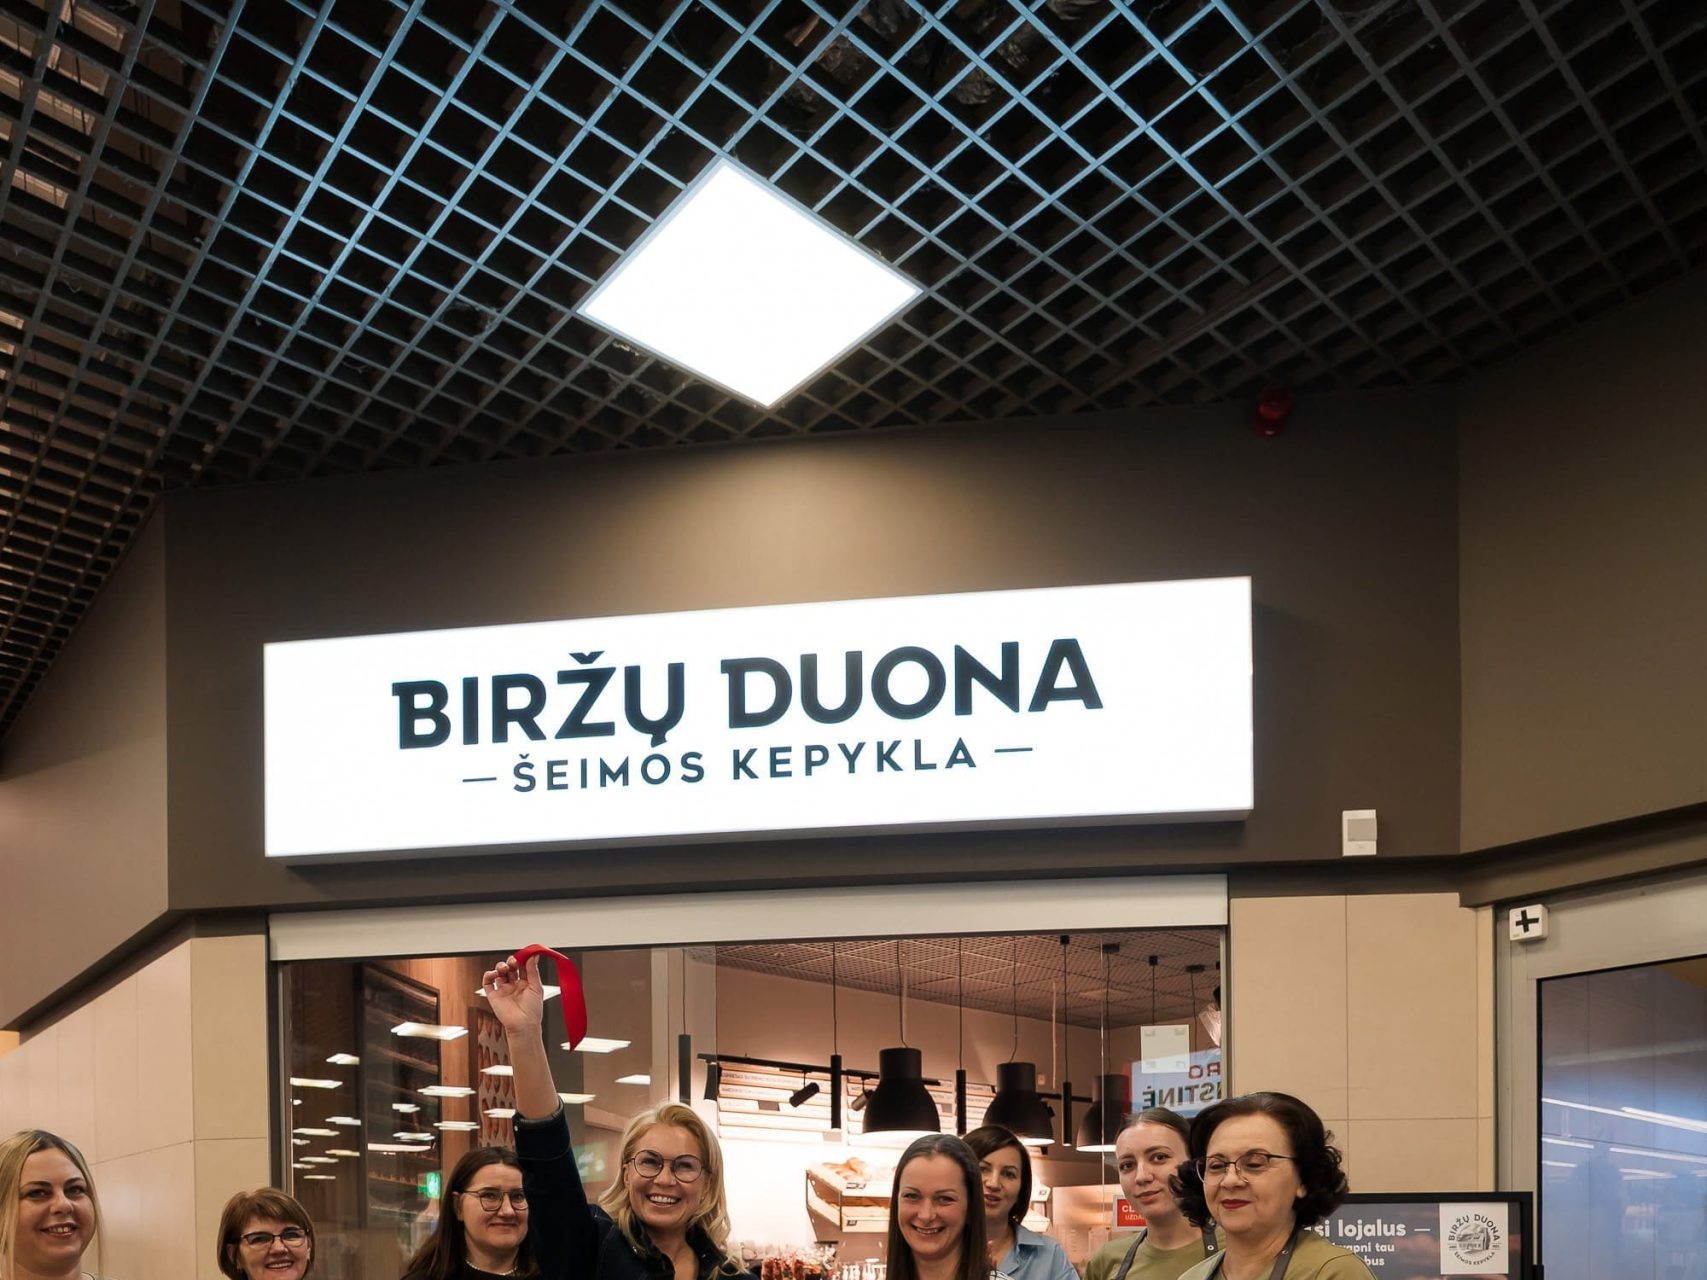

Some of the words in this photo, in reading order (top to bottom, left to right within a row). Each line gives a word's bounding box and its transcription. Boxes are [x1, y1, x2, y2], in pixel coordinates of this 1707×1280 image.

[392, 651, 684, 750] BIRŽŲ
[721, 639, 1103, 729] DUONA
[514, 753, 704, 793] ŠEIMOS
[733, 738, 976, 781] KEPYKLA
[1338, 1219, 1407, 1241] lojalus
[1473, 1213, 1501, 1242] DUONA
[1375, 1243, 1395, 1253] tau
